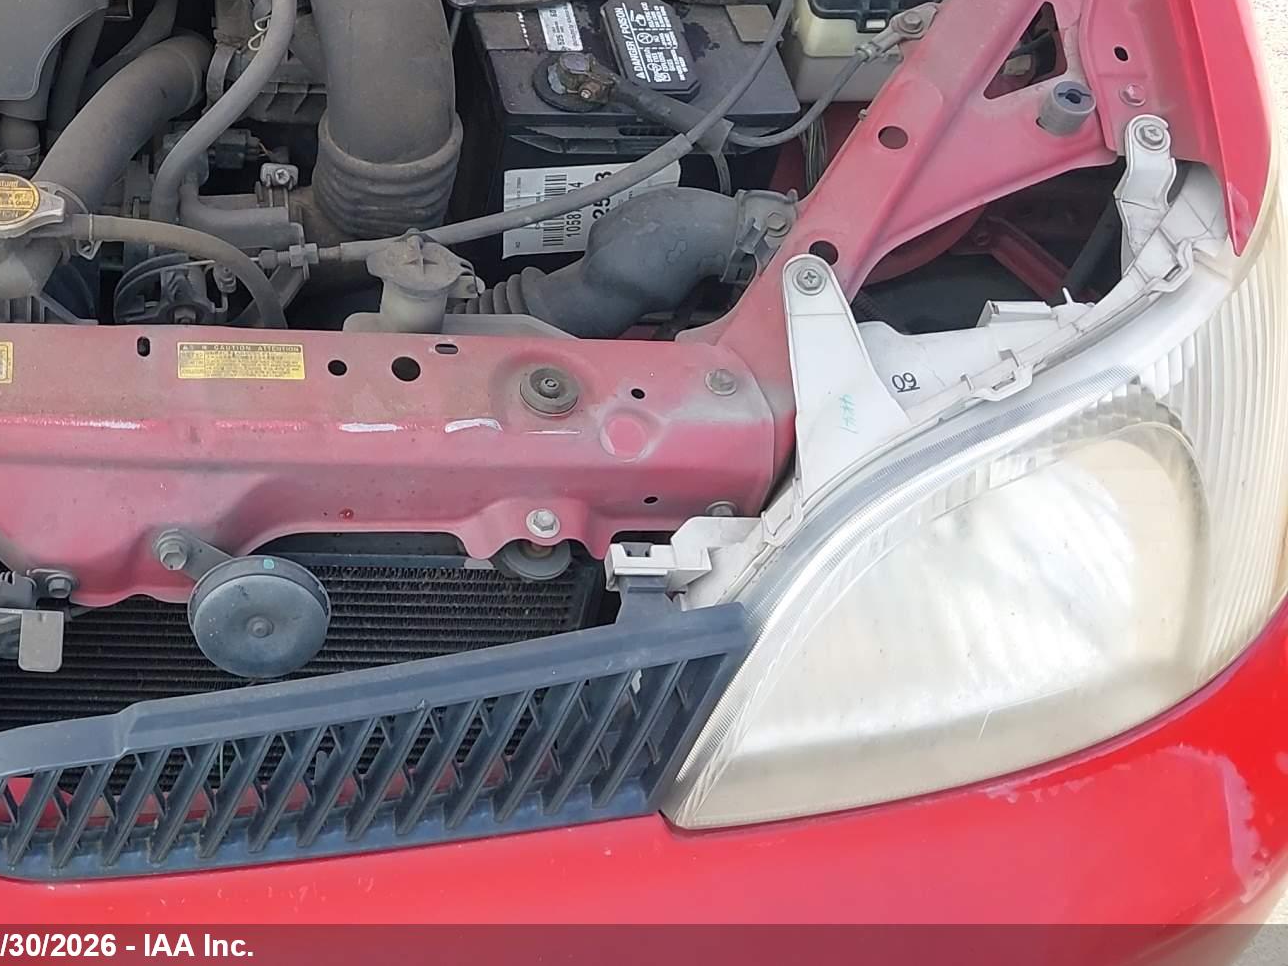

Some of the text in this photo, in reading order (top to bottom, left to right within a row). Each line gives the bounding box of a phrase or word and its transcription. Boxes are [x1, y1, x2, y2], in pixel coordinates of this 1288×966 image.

[614, 7, 630, 33] POISON
[625, 40, 643, 71] DANGER
[892, 372, 918, 390] 09
